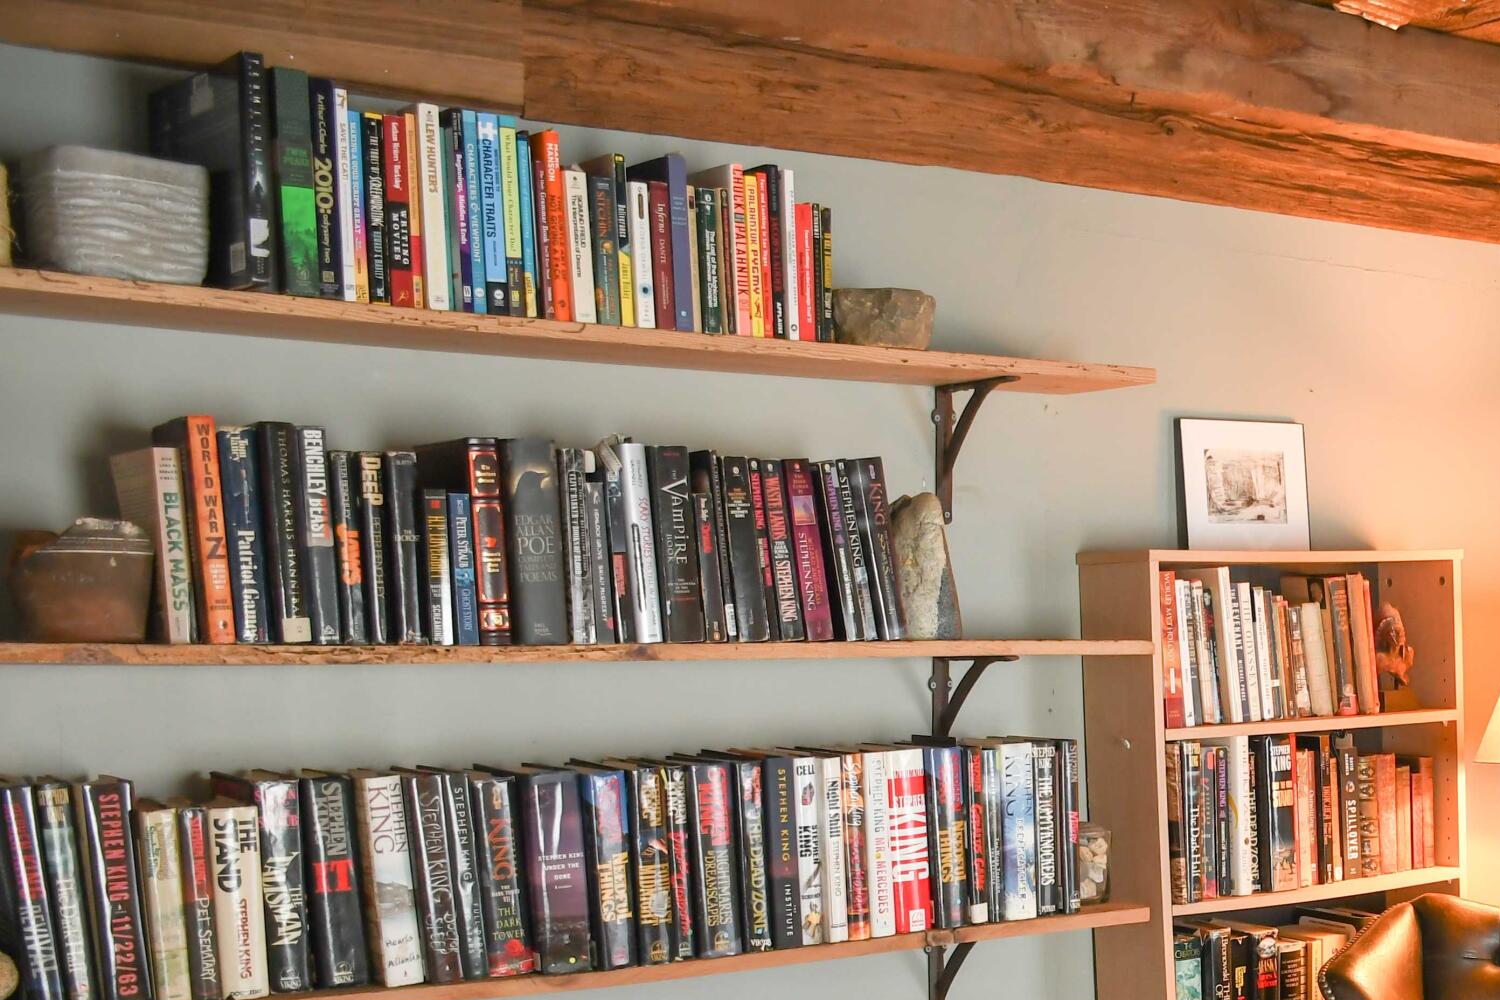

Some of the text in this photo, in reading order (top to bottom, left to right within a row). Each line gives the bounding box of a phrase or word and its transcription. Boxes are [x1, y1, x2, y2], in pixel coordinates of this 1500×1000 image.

[317, 94, 327, 121] Arthur
[425, 122, 438, 193] LEW HUNTER'S
[482, 139, 495, 199] CHARACTER
[503, 135, 512, 154] What
[505, 156, 513, 178] Would
[546, 142, 555, 182] MANSON
[314, 157, 333, 214] 2010:
[369, 176, 384, 226] SCREENWRITING
[467, 144, 480, 263] CHARACTERS VIEWPOINT
[322, 214, 331, 246] odyssey
[353, 207, 361, 234] GREAT
[392, 213, 400, 261] MOVIES
[400, 210, 409, 265] WRITING
[487, 203, 497, 238] TRAITS
[617, 204, 628, 238] Deliverance
[657, 203, 666, 233] Inferno
[732, 168, 749, 295] CHUCK PALAHNIUK
[748, 188, 761, 293] PALAHNIUK PYGMY
[776, 302, 784, 334] APPLAUSE
[239, 439, 248, 457] Tom
[197, 424, 225, 559] WORLD WAR Z
[278, 431, 293, 540] THOMAS HARRIS
[303, 430, 330, 540] BENCHLEY BEAST
[361, 457, 383, 505] DEEP
[569, 473, 577, 491] CLIVE
[752, 473, 764, 529] STEPHEN KING
[765, 475, 787, 540] WASTE LANDS
[869, 483, 885, 525] KING
[515, 514, 553, 525] EDGAR
[516, 524, 554, 537] ALLAN
[639, 497, 649, 521] SCARY
[832, 511, 842, 531] KING
[839, 476, 862, 567] STEPHEN KING
[163, 492, 187, 611] BLACK MASS
[427, 515, 447, 578] H.P. LOVECRAFT
[456, 517, 471, 568] PETER STRAUB
[517, 537, 555, 555] POE
[641, 527, 652, 558] STORIES
[666, 534, 674, 561] BOOK
[237, 530, 259, 641] Patriot Games
[520, 572, 557, 581] POEMS
[776, 560, 798, 622] STEPHEN KING
[798, 532, 815, 610] STEPHEN KING
[1164, 572, 1173, 605] WORLD
[462, 589, 473, 632] GHOST STORY
[1231, 602, 1242, 650] REVENANT
[1238, 660, 1246, 684] MICHAEL
[1242, 600, 1257, 688] THE ODYSSEY
[796, 764, 815, 776] CELL
[843, 761, 863, 800] Stephen
[1004, 756, 1021, 817] KING
[1024, 753, 1033, 817] STEPHEN
[1069, 744, 1078, 783] STEPHEN
[1272, 755, 1291, 771] KING
[321, 782, 347, 856] STEPHEN
[368, 786, 394, 855] KING
[388, 783, 407, 853] STEPHEN
[698, 783, 715, 835] KING
[777, 768, 790, 861] STEPHEN KING
[826, 780, 841, 838] Night Shift
[847, 804, 864, 826] King
[873, 808, 884, 833] KING
[1323, 786, 1331, 820] DRACULA
[213, 818, 242, 893] STAND
[239, 818, 257, 853] THE
[419, 792, 451, 903] STEPHEN KING
[454, 787, 473, 881] STEPHEN KING
[488, 817, 514, 881] KING
[811, 824, 820, 864] STEPHEN
[889, 806, 929, 883] KING
[1038, 775, 1055, 886] THE TOMMYKNOCKERS
[1190, 805, 1201, 877] The Dark Half
[1249, 817, 1258, 846] DEAD
[1347, 800, 1358, 860] SPILLOVER
[312, 859, 353, 894] IT
[612, 851, 632, 925] NEEDFUL
[717, 848, 733, 925] NIGHTMARES
[749, 846, 769, 935] DEAD ZONE
[876, 861, 889, 914] MERCEDES
[1251, 848, 1259, 881] ZONE
[98, 793, 138, 996] STEPHEN KING 11/22/63
[196, 895, 211, 927] PET
[261, 852, 302, 947] TALISMAN
[290, 885, 304, 907] THE
[499, 907, 516, 916] THE
[597, 862, 616, 923] THINGS
[639, 863, 657, 927] MIDNIGHT
[704, 856, 719, 927] DREAMSCAPES
[784, 884, 793, 937] INSTITUTE
[199, 929, 217, 983] SEMATARY
[237, 898, 252, 979] STEPHEN KING
[492, 929, 525, 940] TOWER
[1215, 984, 1222, 999] OF
